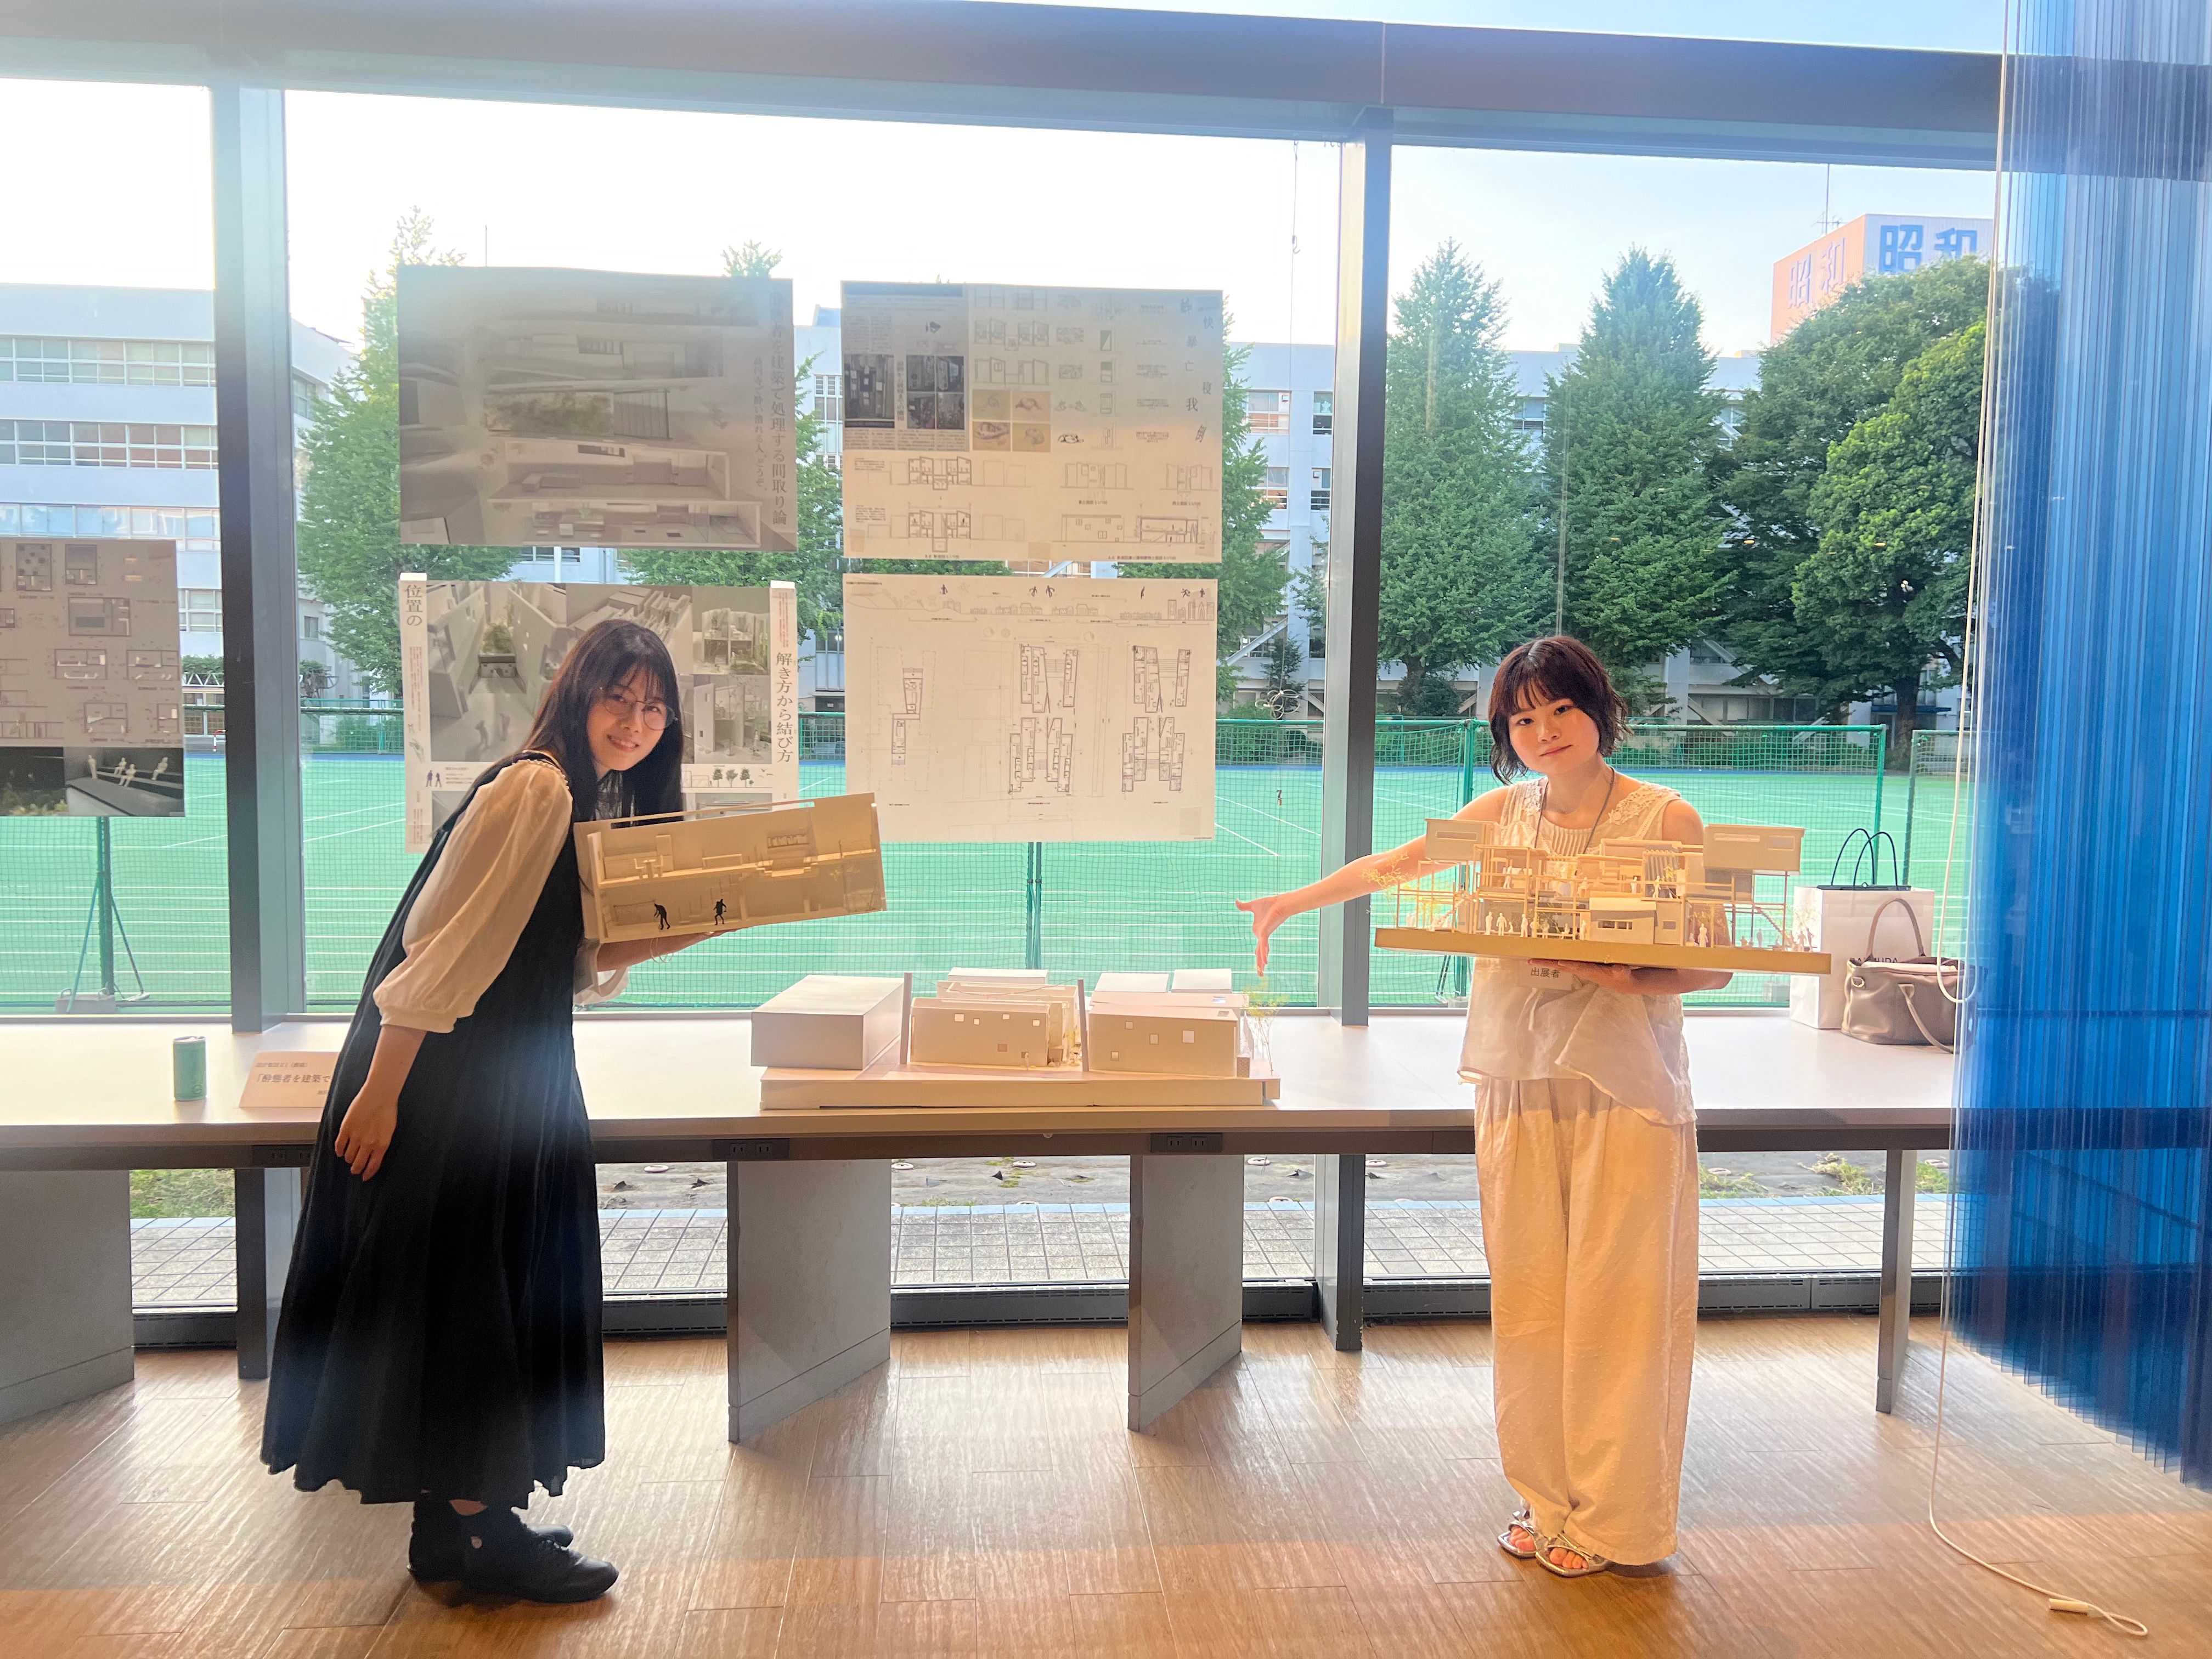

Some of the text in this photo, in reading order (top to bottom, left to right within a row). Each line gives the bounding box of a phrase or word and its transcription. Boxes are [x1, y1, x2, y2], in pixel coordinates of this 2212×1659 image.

[1880, 224, 1978, 274] 昭和
[1788, 237, 1846, 309] 昭和
[1186, 397, 1199, 411] 我
[404, 584, 424, 626] 位置の
[775, 652, 794, 763] 解き方から結び方
[1531, 967, 1560, 978] 出展者
